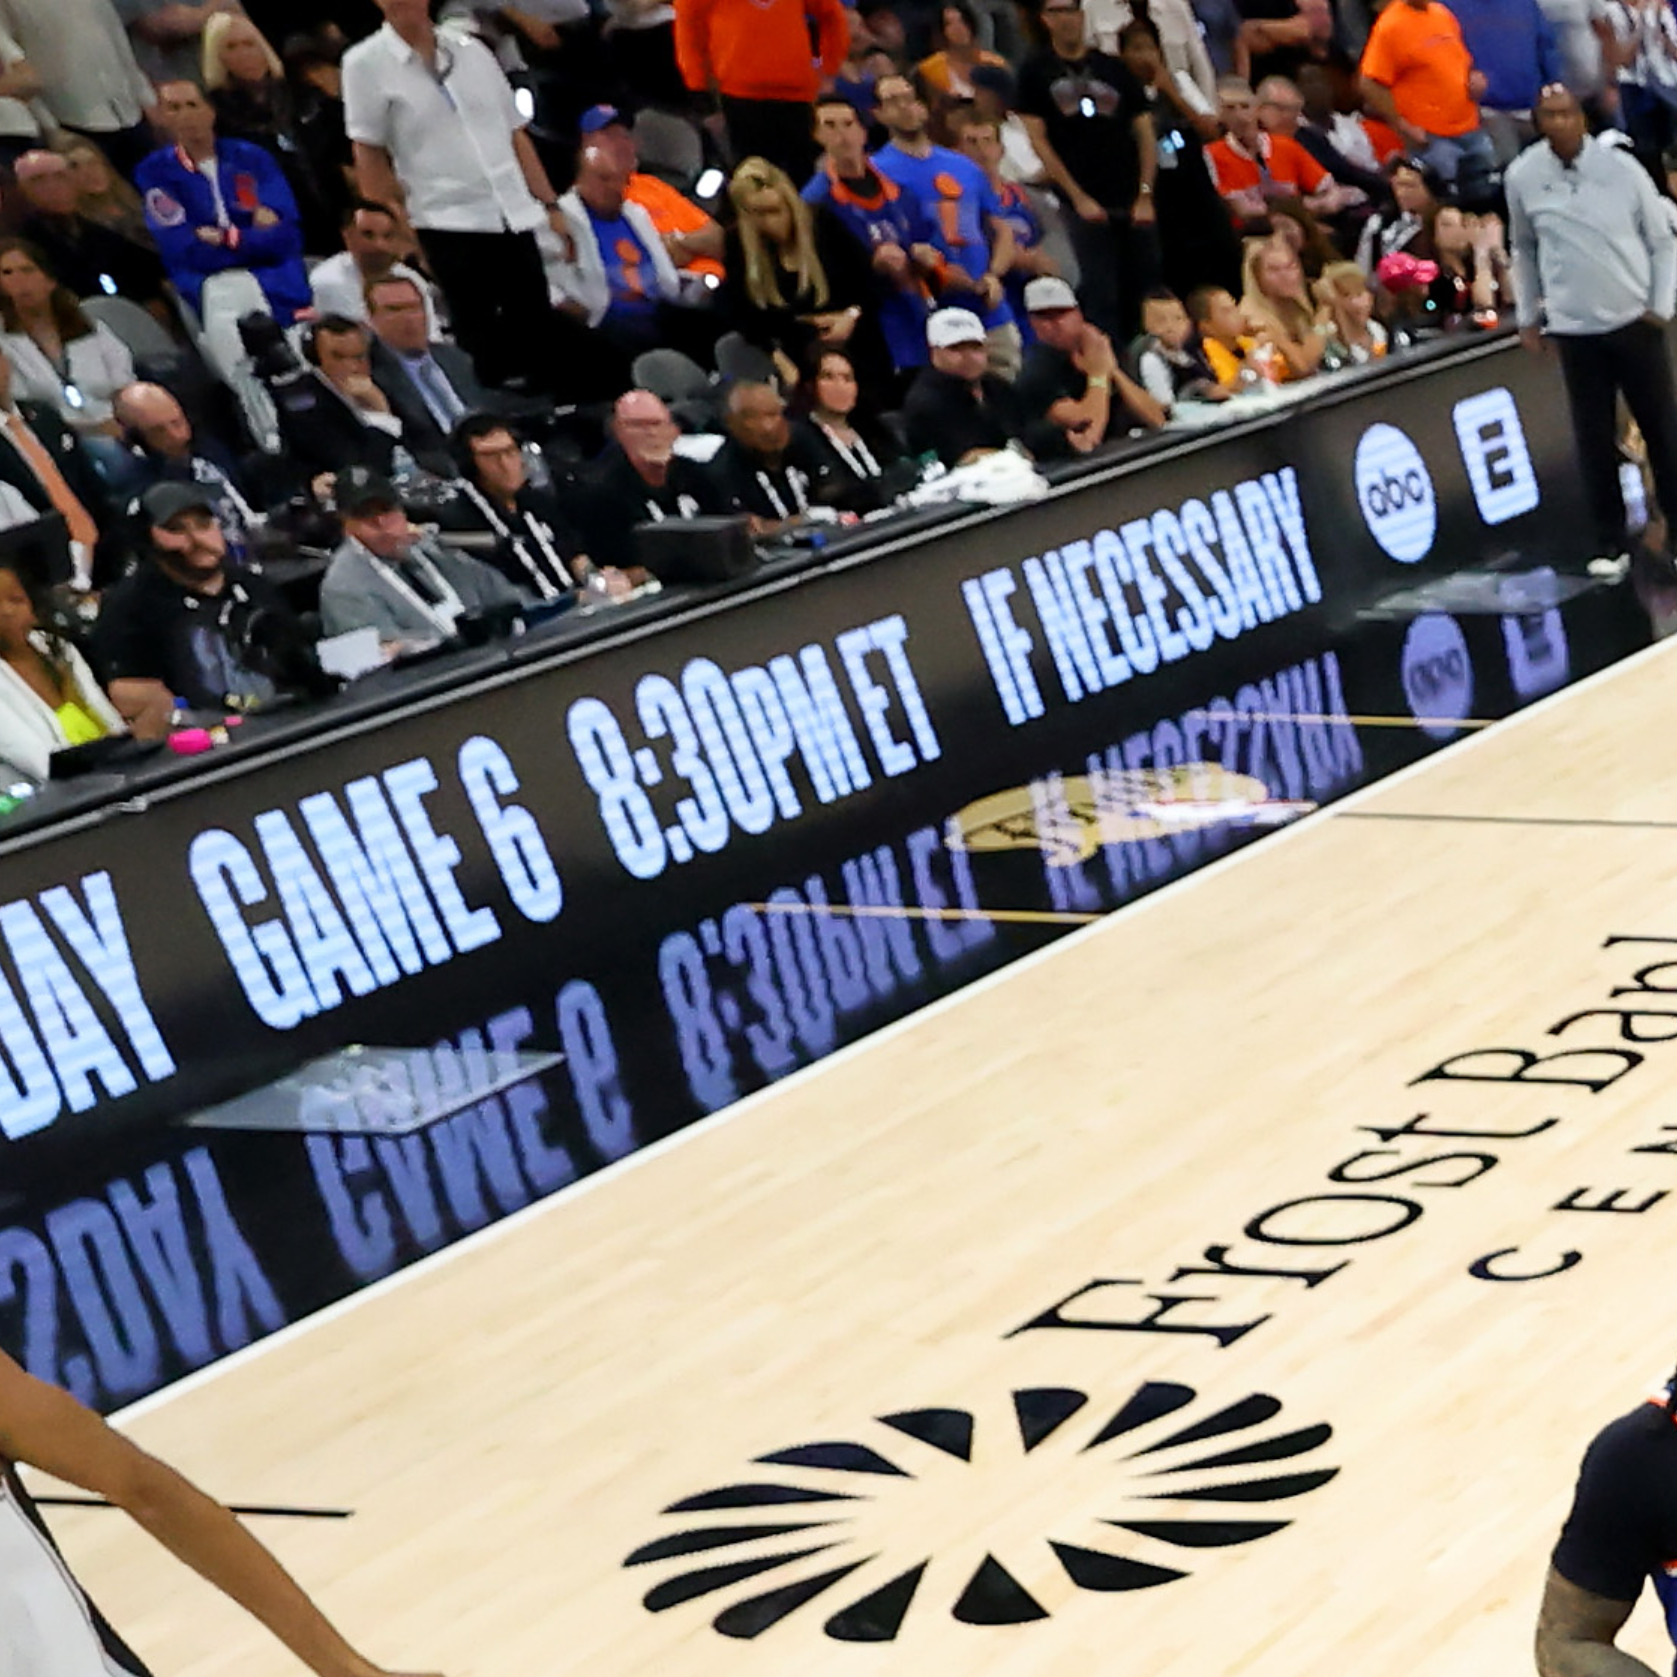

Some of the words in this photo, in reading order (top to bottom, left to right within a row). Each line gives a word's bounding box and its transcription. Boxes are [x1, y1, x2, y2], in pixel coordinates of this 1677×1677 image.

[1366, 465, 1427, 520] abc
[188, 757, 502, 1030] GAME
[457, 734, 564, 923] 6
[565, 643, 872, 881] 8:30PM
[837, 614, 942, 780] ET
[961, 567, 1046, 726] IF
[1021, 465, 1322, 703] NECESSARY
[1001, 1111, 1559, 1350] Frost
